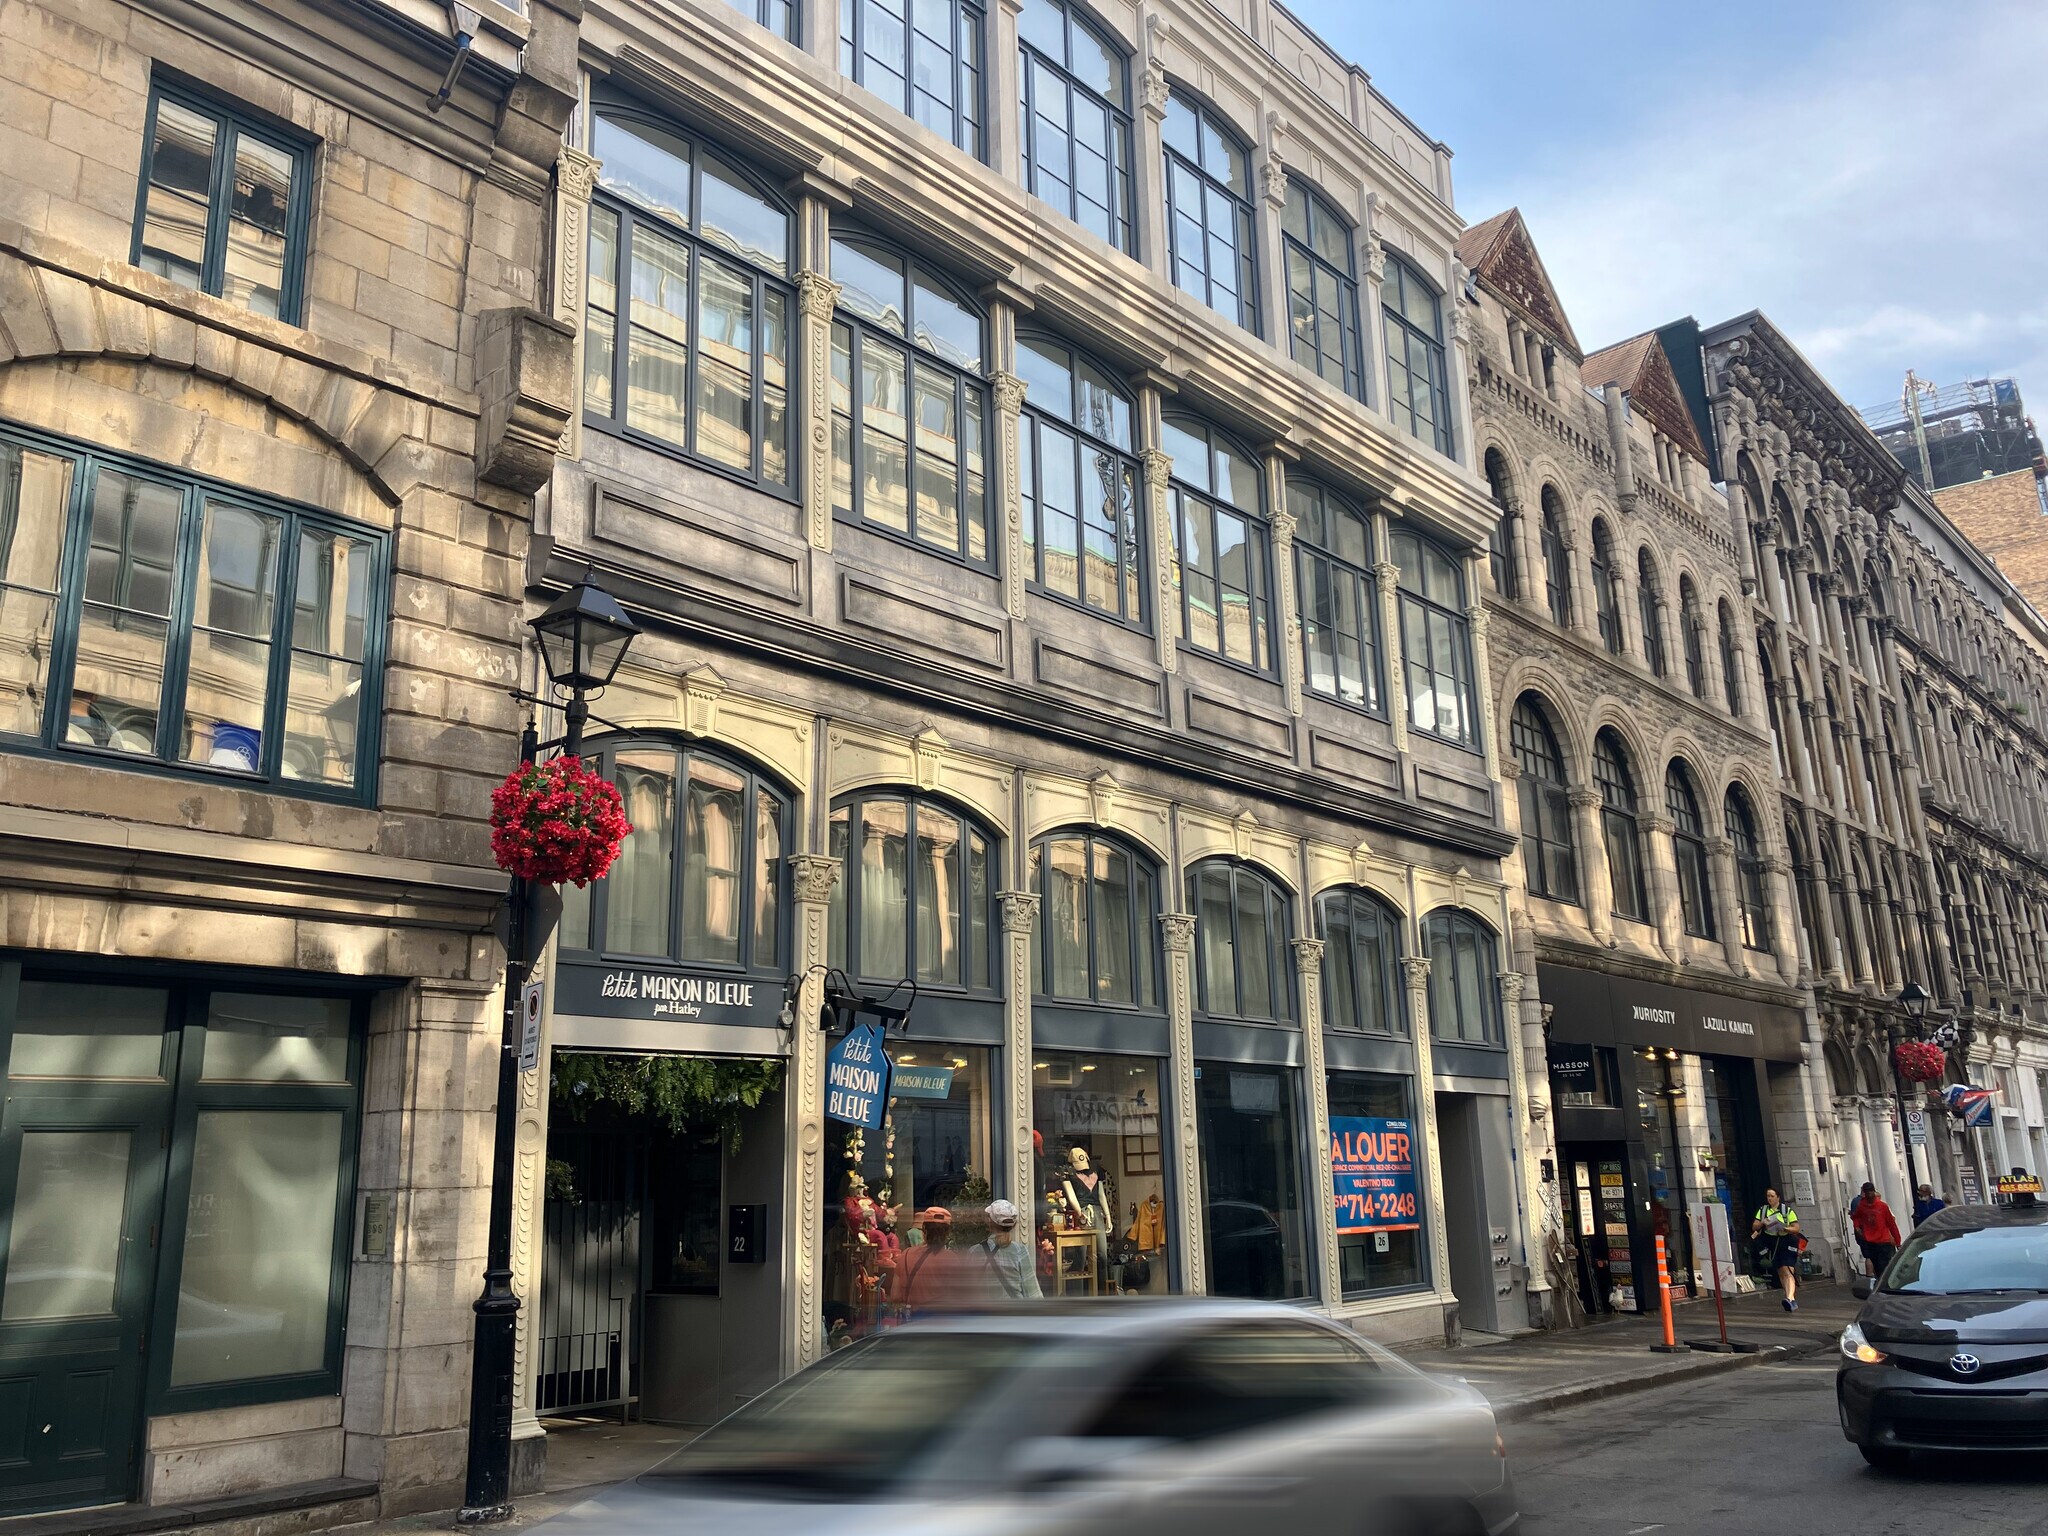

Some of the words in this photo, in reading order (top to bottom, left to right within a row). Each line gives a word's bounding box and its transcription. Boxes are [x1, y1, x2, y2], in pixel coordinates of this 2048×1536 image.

[601, 971, 637, 998] Petite
[642, 975, 701, 1002] MAISON
[706, 981, 754, 1007] BLEUE
[654, 1003, 668, 1016] par
[669, 1001, 702, 1018] Hatley
[1632, 1005, 1676, 1024] KURIOSITY
[1702, 1016, 1727, 1032] LAZULI
[1728, 1020, 1755, 1035] KANATA
[843, 1036, 872, 1064] Petite
[1552, 1061, 1589, 1070] MASSON
[829, 1062, 880, 1095] MAISON
[894, 1075, 921, 1087] MAISON
[922, 1078, 947, 1090] BLEUE
[829, 1090, 872, 1123] BLEUE
[1331, 1132, 1344, 1162] À
[1345, 1132, 1411, 1162] LOUER
[1352, 1179, 1380, 1188] VALENTINO
[2000, 1175, 2035, 1183] ATLAS
[1348, 1192, 1416, 1220] 714-2248
[734, 1236, 745, 1251] 22
[1378, 1236, 1386, 1247] 26
